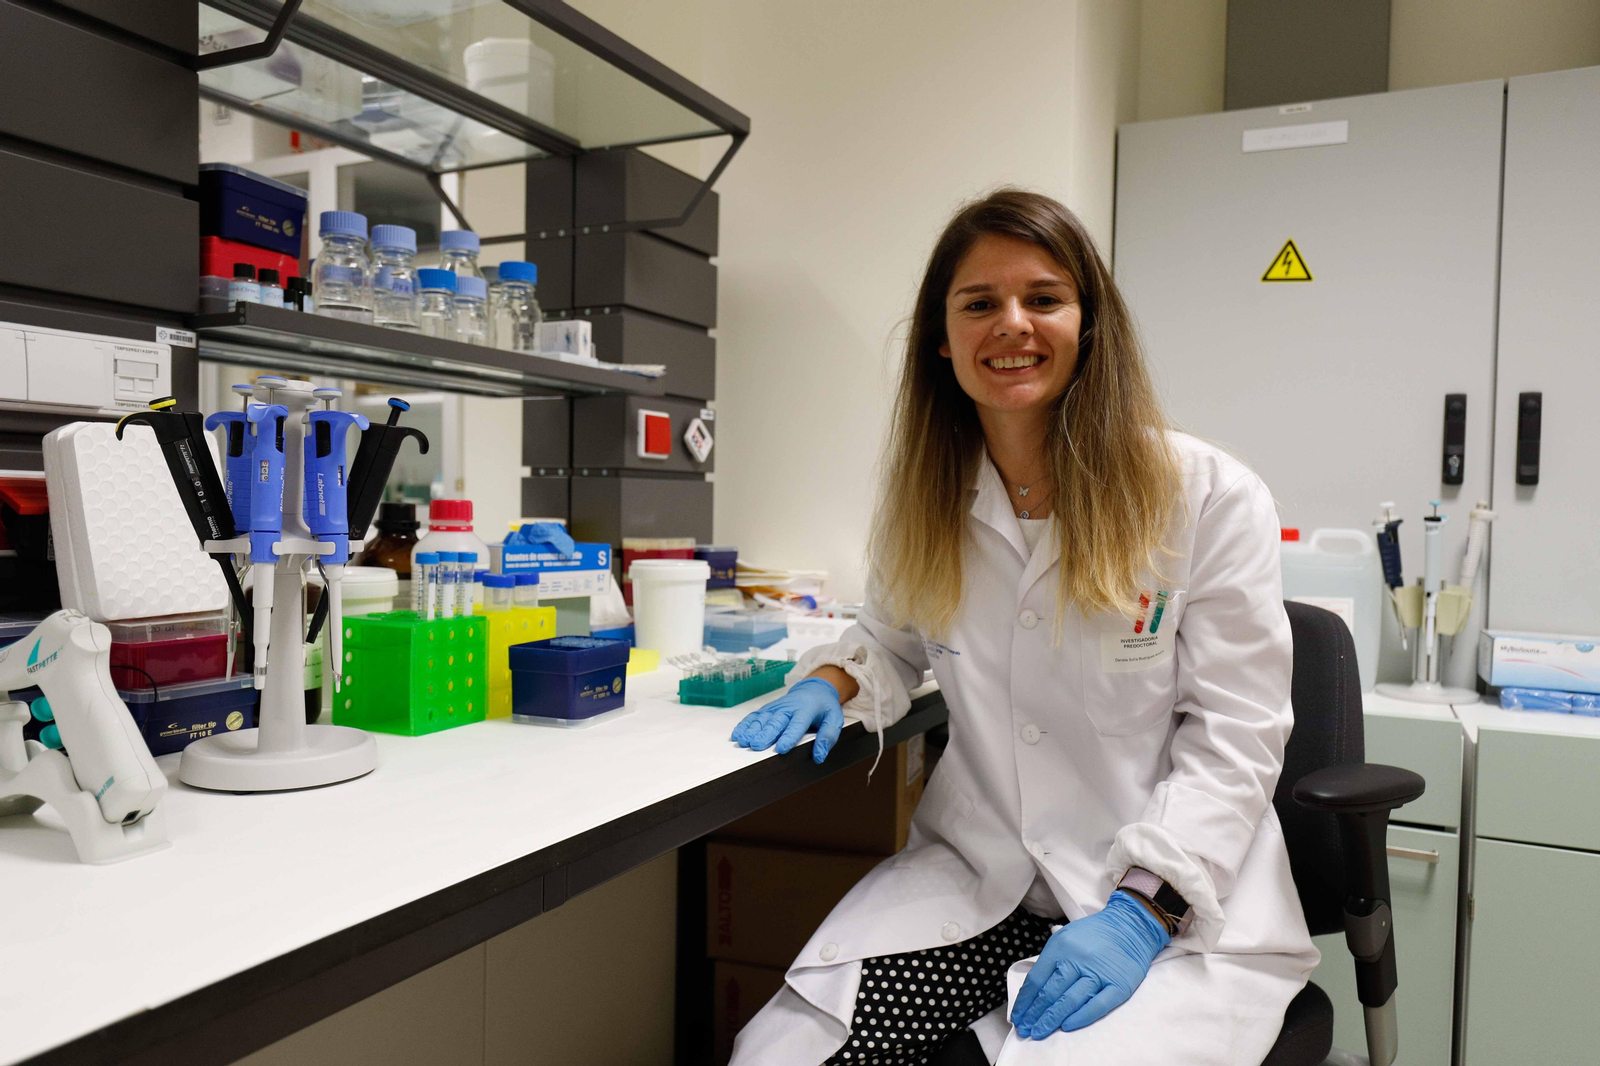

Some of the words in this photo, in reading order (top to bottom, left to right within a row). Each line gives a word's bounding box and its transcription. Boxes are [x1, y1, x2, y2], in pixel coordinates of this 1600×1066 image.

[598, 550, 607, 566] S
[27, 651, 58, 674] FASTPETTE
[190, 731, 198, 740] FT
